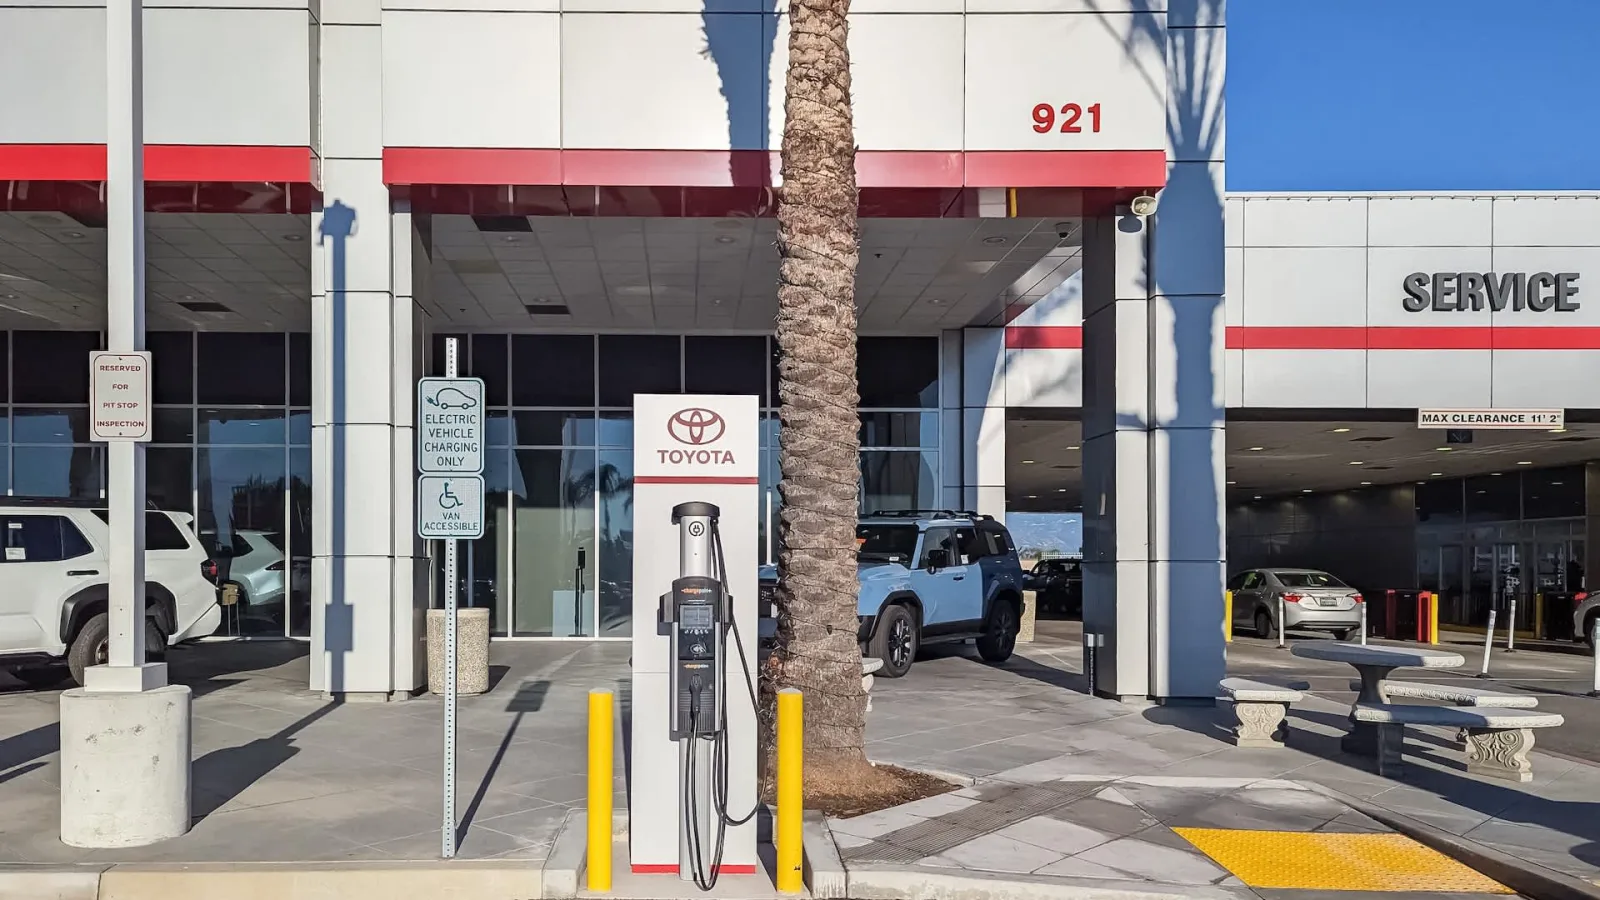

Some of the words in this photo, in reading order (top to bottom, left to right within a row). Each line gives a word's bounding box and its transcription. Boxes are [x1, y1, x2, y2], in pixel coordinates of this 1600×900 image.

[1032, 103, 1101, 133] 921
[1402, 272, 1580, 312] SERVICE
[425, 414, 477, 424] ELECTRIC
[1422, 414, 1448, 423] MAX
[1452, 414, 1525, 423] CLEARANCE
[428, 428, 474, 438] VEHICLE
[424, 442, 478, 452] CHARGING
[436, 456, 465, 466] ONLY
[657, 450, 735, 464] TOYOTA
[442, 512, 460, 520] VAN
[424, 522, 479, 531] ACCESSIBLE
